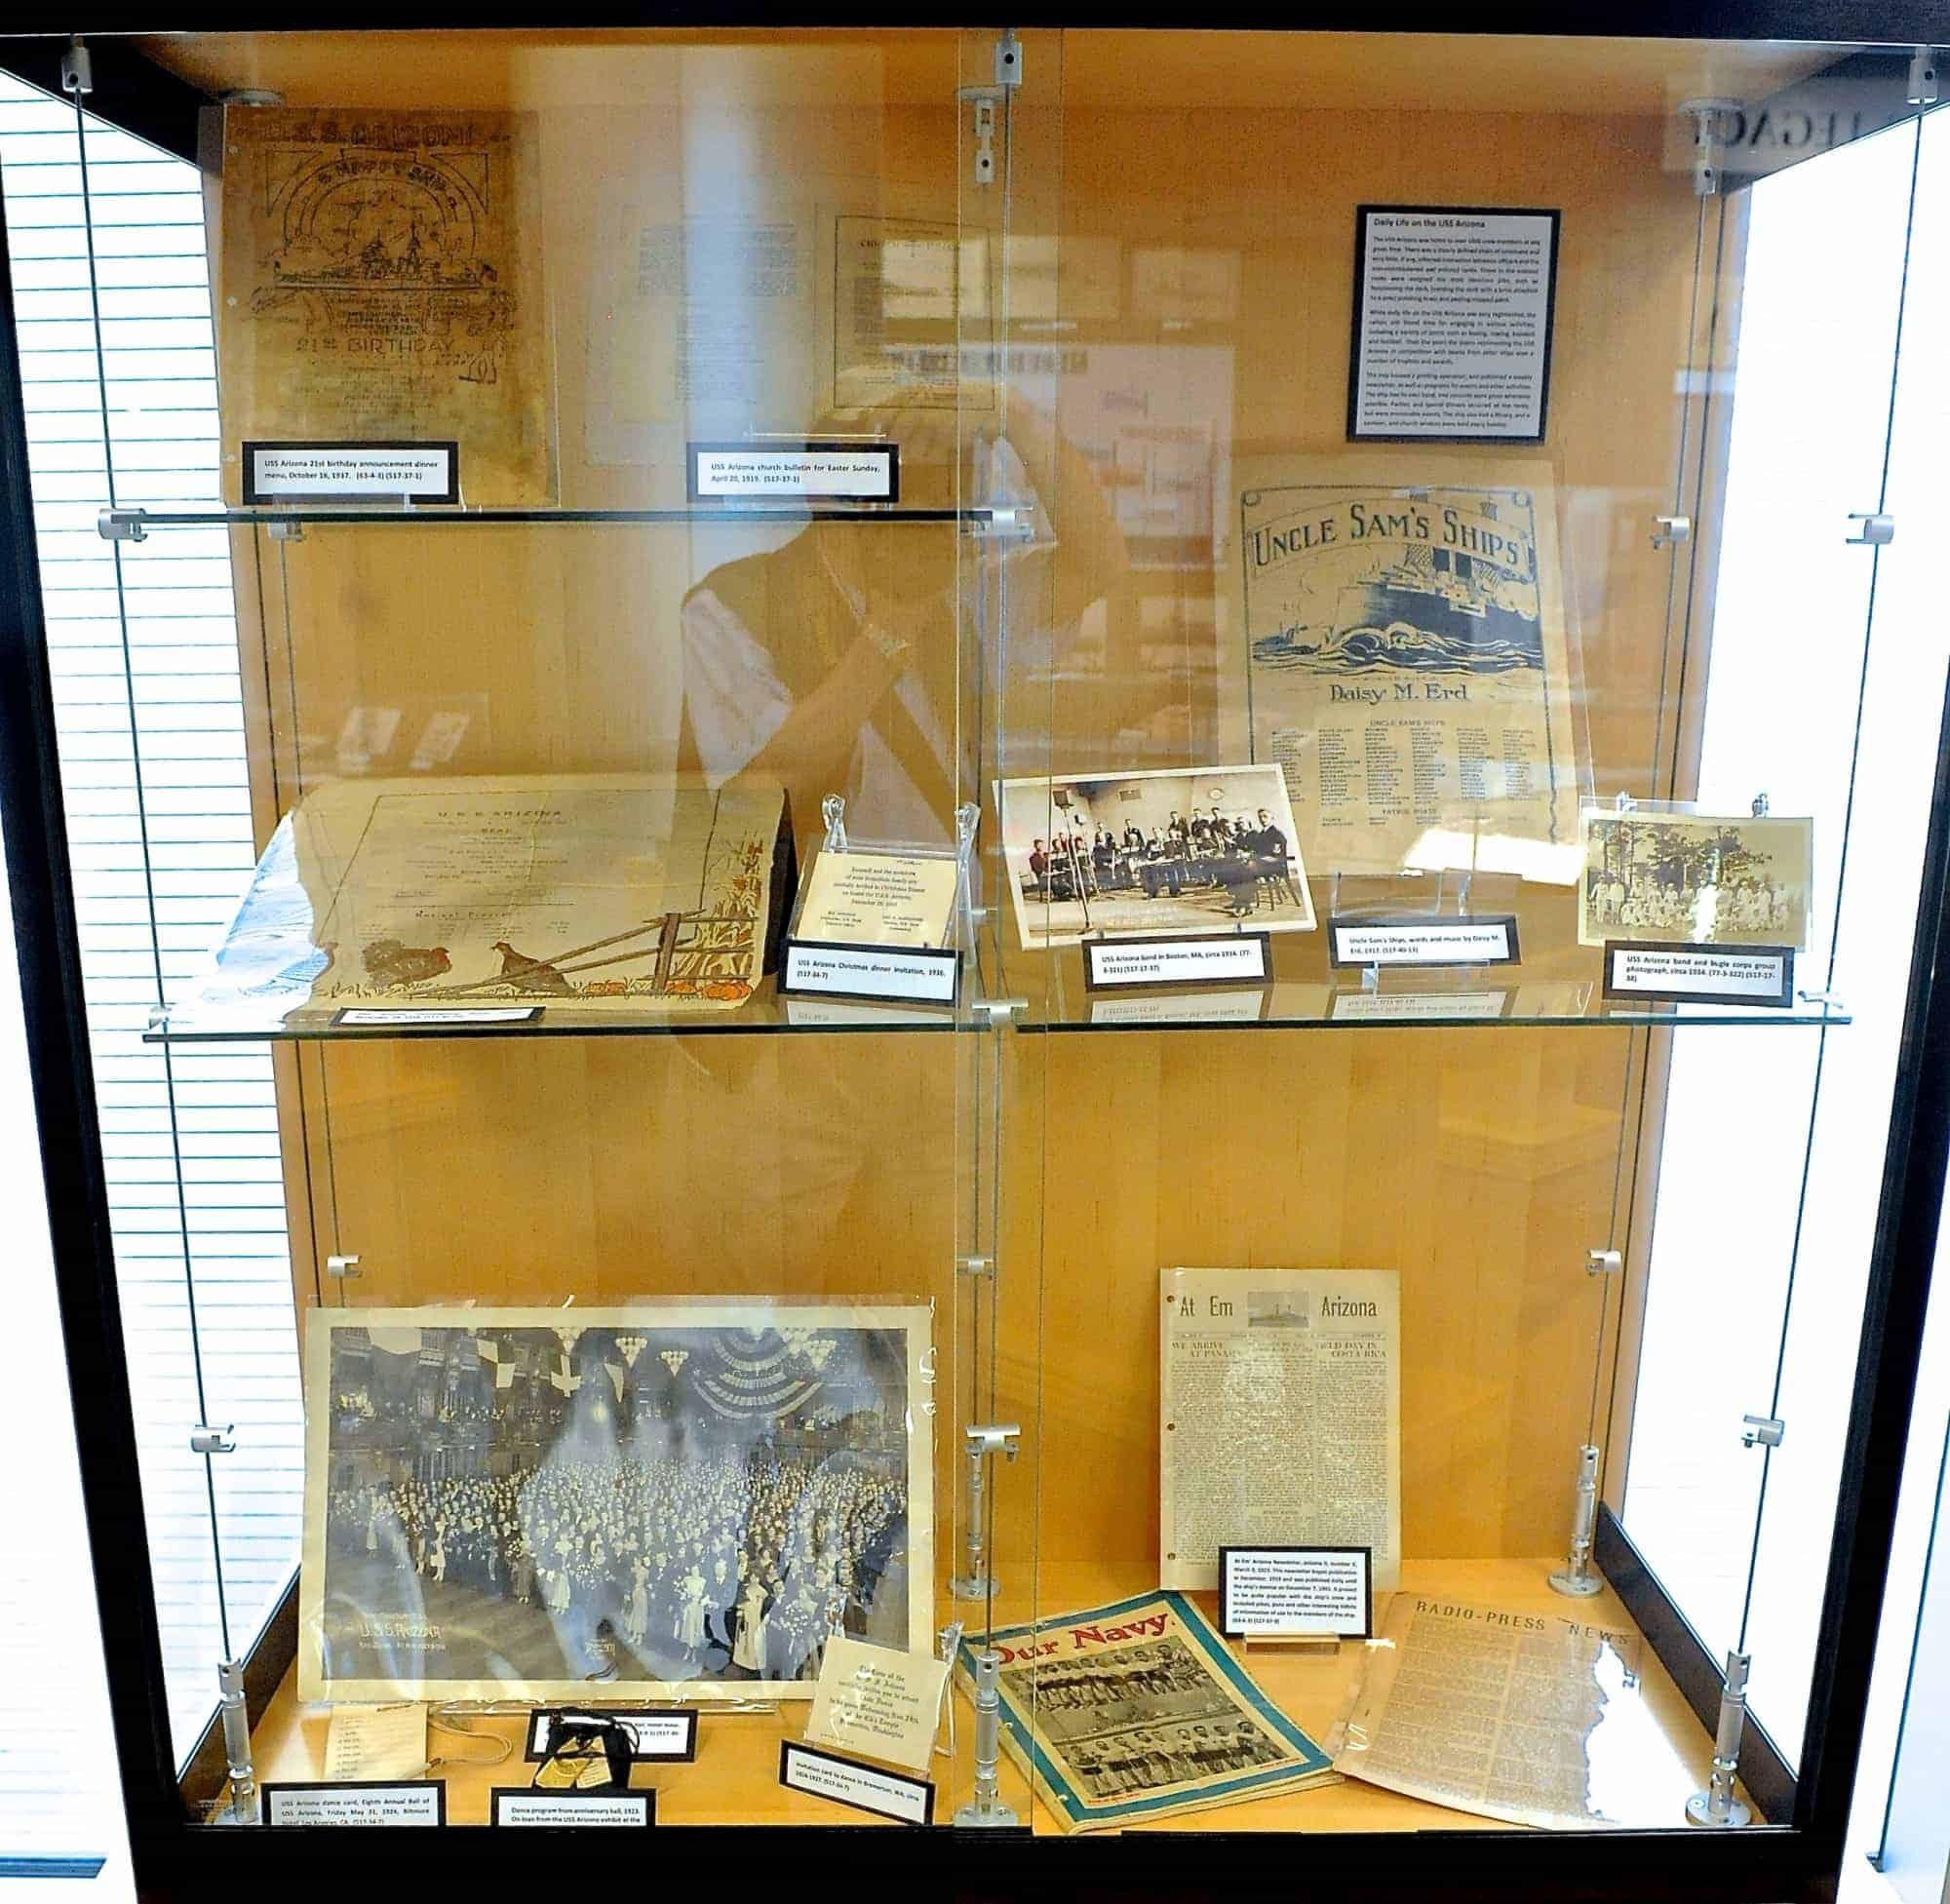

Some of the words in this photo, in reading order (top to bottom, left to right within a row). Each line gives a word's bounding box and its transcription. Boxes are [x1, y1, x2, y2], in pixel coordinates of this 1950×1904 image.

[1374, 218, 1392, 228] Daily
[328, 461, 357, 470] birthday
[853, 464, 880, 474] Sunday,
[1254, 518, 1339, 567] UNCLE
[1349, 503, 1430, 539] SAM'S
[1443, 509, 1518, 564] SHIPS
[1329, 683, 1386, 706] Daisy
[1394, 684, 1419, 700] M.
[1425, 683, 1467, 700] Erd
[838, 962, 869, 971] Christmas
[1626, 966, 1668, 976] photograph,
[1710, 960, 1729, 969] bugle
[1732, 961, 1751, 970] corps
[1754, 962, 1775, 972] group
[1180, 1296, 1194, 1317] At
[1210, 1296, 1233, 1317] Em
[1321, 1296, 1377, 1318] Arizona
[1416, 1600, 1545, 1631] RADIO-PRESS
[1568, 1623, 1629, 1646] NEWS
[991, 1641, 1059, 1666] Our
[362, 1799, 381, 1807] Eighth
